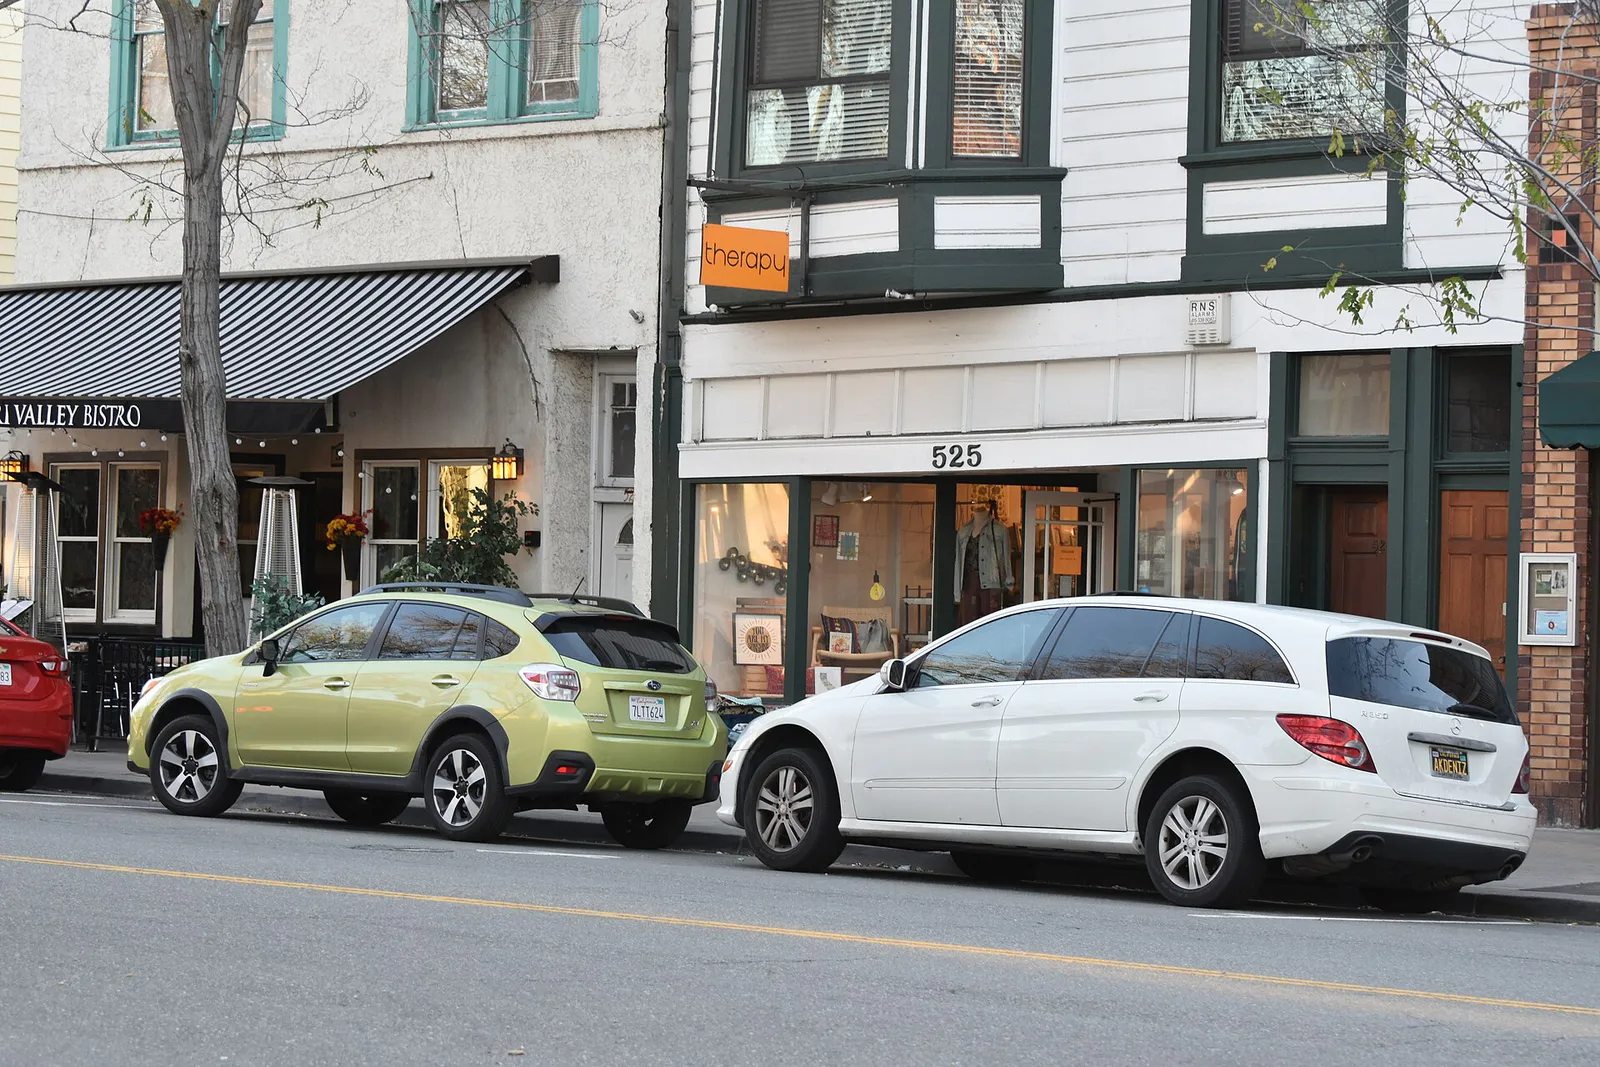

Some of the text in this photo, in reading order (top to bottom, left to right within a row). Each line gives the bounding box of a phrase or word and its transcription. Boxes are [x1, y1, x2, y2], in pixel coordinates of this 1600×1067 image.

[705, 241, 786, 277] therapy
[1191, 301, 1215, 311] RNS
[14, 404, 79, 426] VALLEY
[83, 404, 141, 427] BISTRO
[932, 444, 982, 469] 525
[632, 704, 664, 719] 7LTT624
[1434, 757, 1468, 776] AKDENIZ
